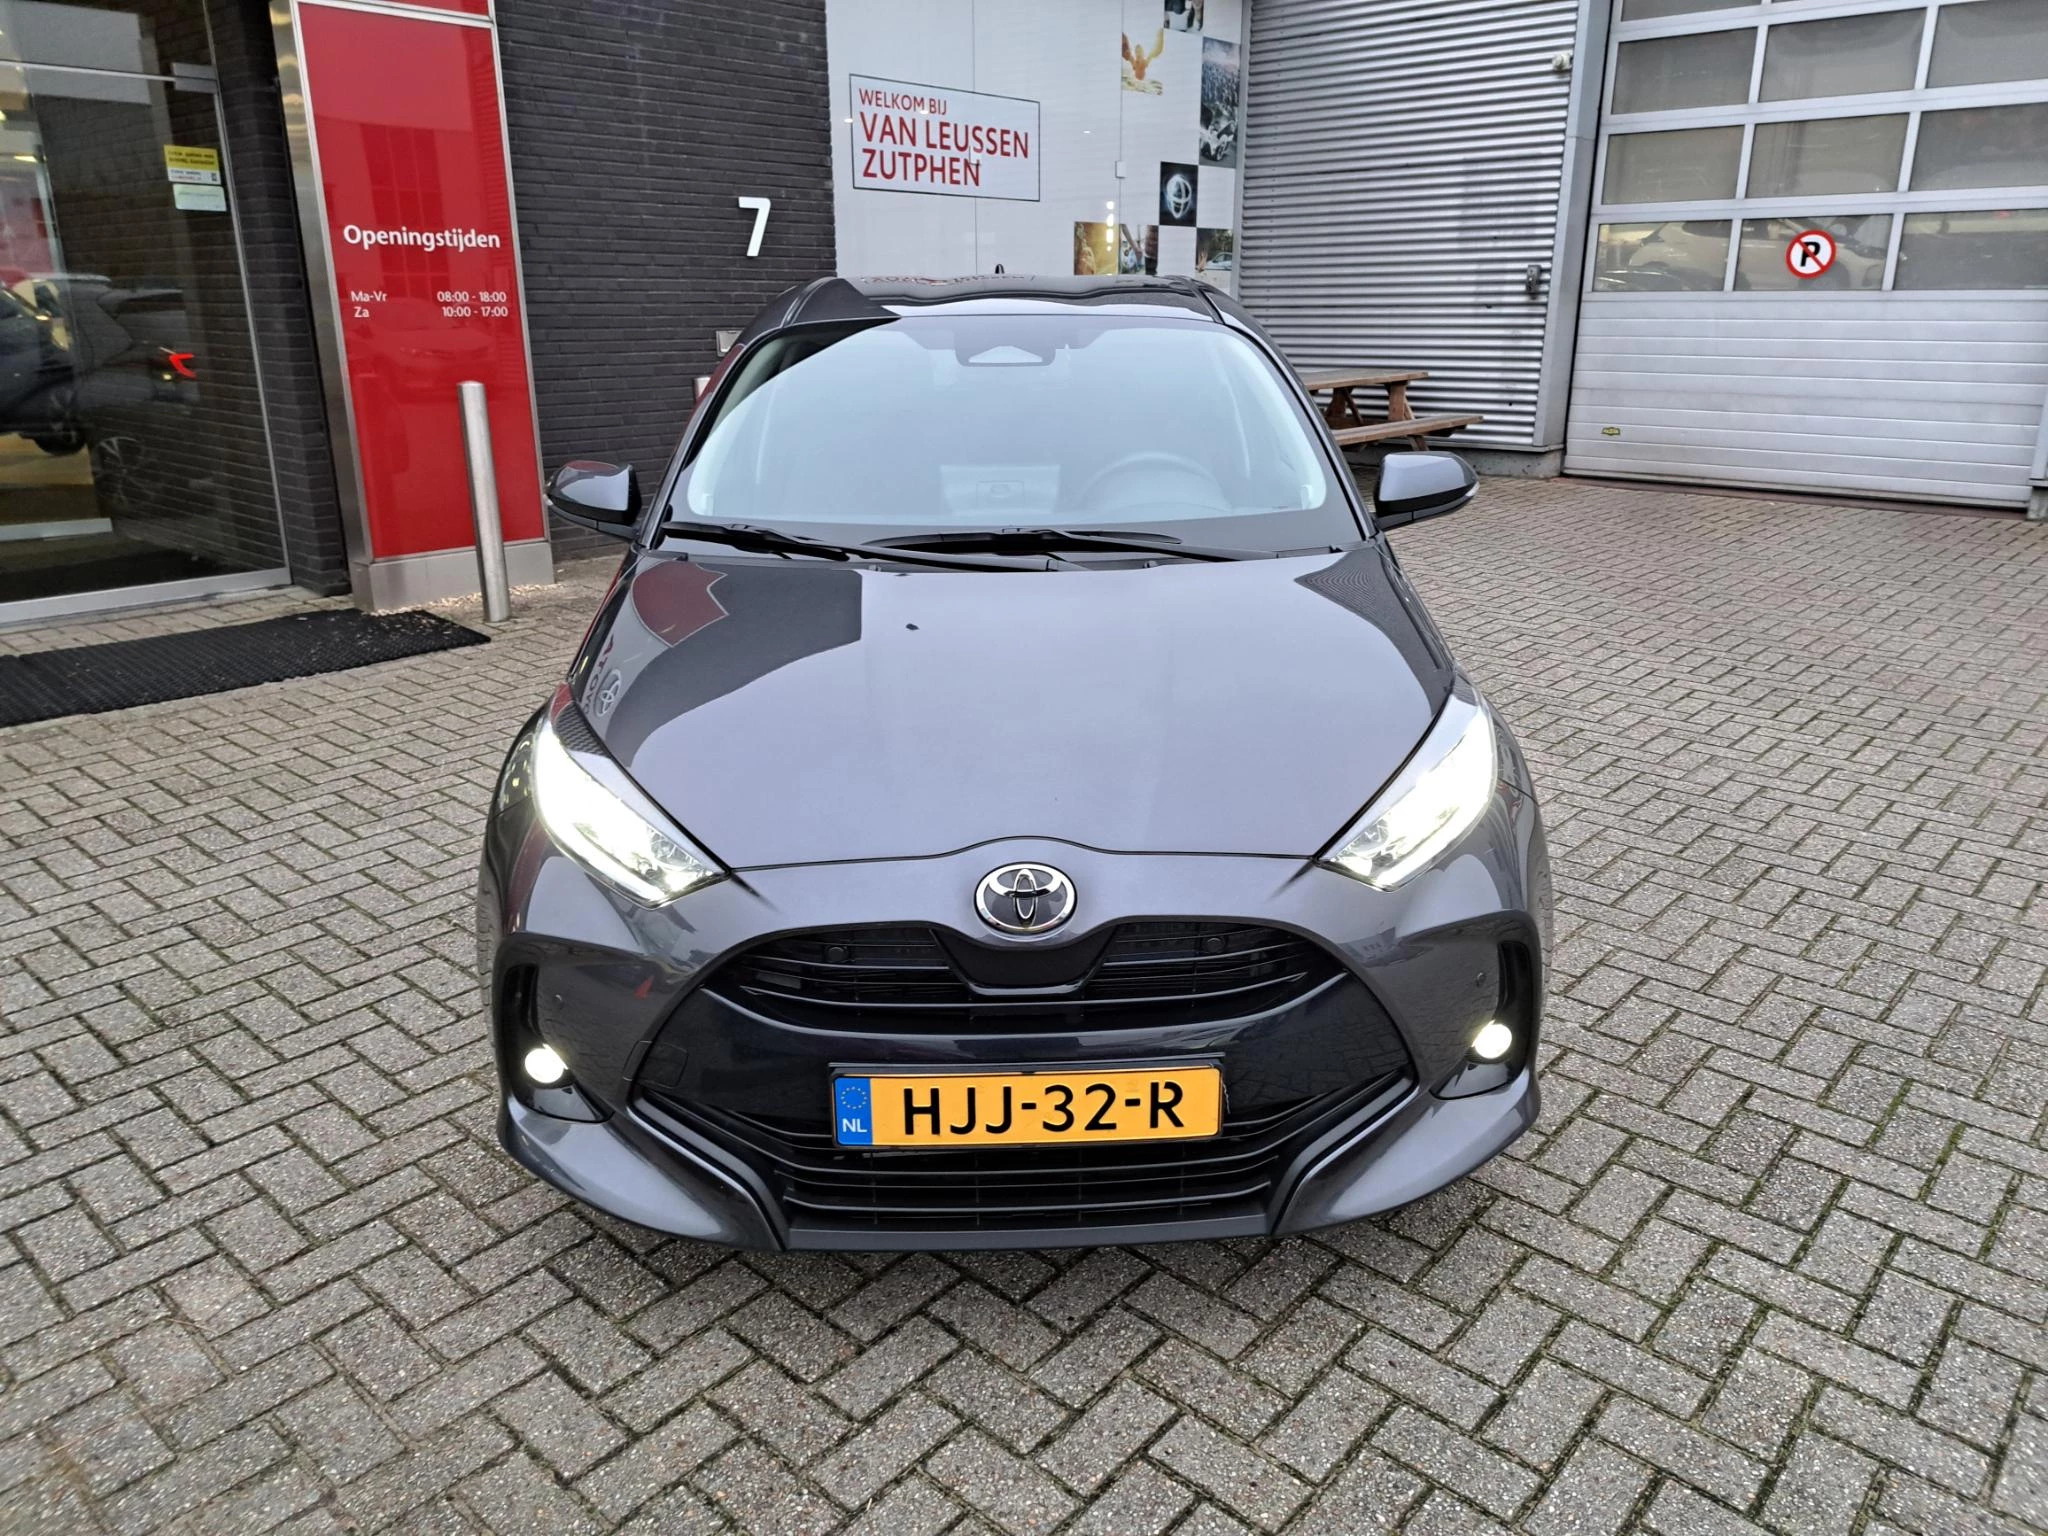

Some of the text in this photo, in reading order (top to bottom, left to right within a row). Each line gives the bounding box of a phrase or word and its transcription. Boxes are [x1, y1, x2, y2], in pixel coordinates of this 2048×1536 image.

[859, 88, 948, 116] WELKOM BIJ
[860, 111, 1028, 159] VAN LEUSSEN
[862, 147, 980, 187] ZUTPHEN
[343, 224, 500, 252] Openingstijden
[738, 196, 771, 257] 7
[350, 291, 388, 302] Ma-Vr
[436, 291, 470, 303] 08:00
[479, 291, 507, 303] 18:00
[354, 306, 370, 318] Za
[442, 306, 472, 318] 10:00
[481, 306, 509, 318] 17:00
[903, 1081, 1185, 1136] HJJ-32-R
[841, 1118, 868, 1133] NL
